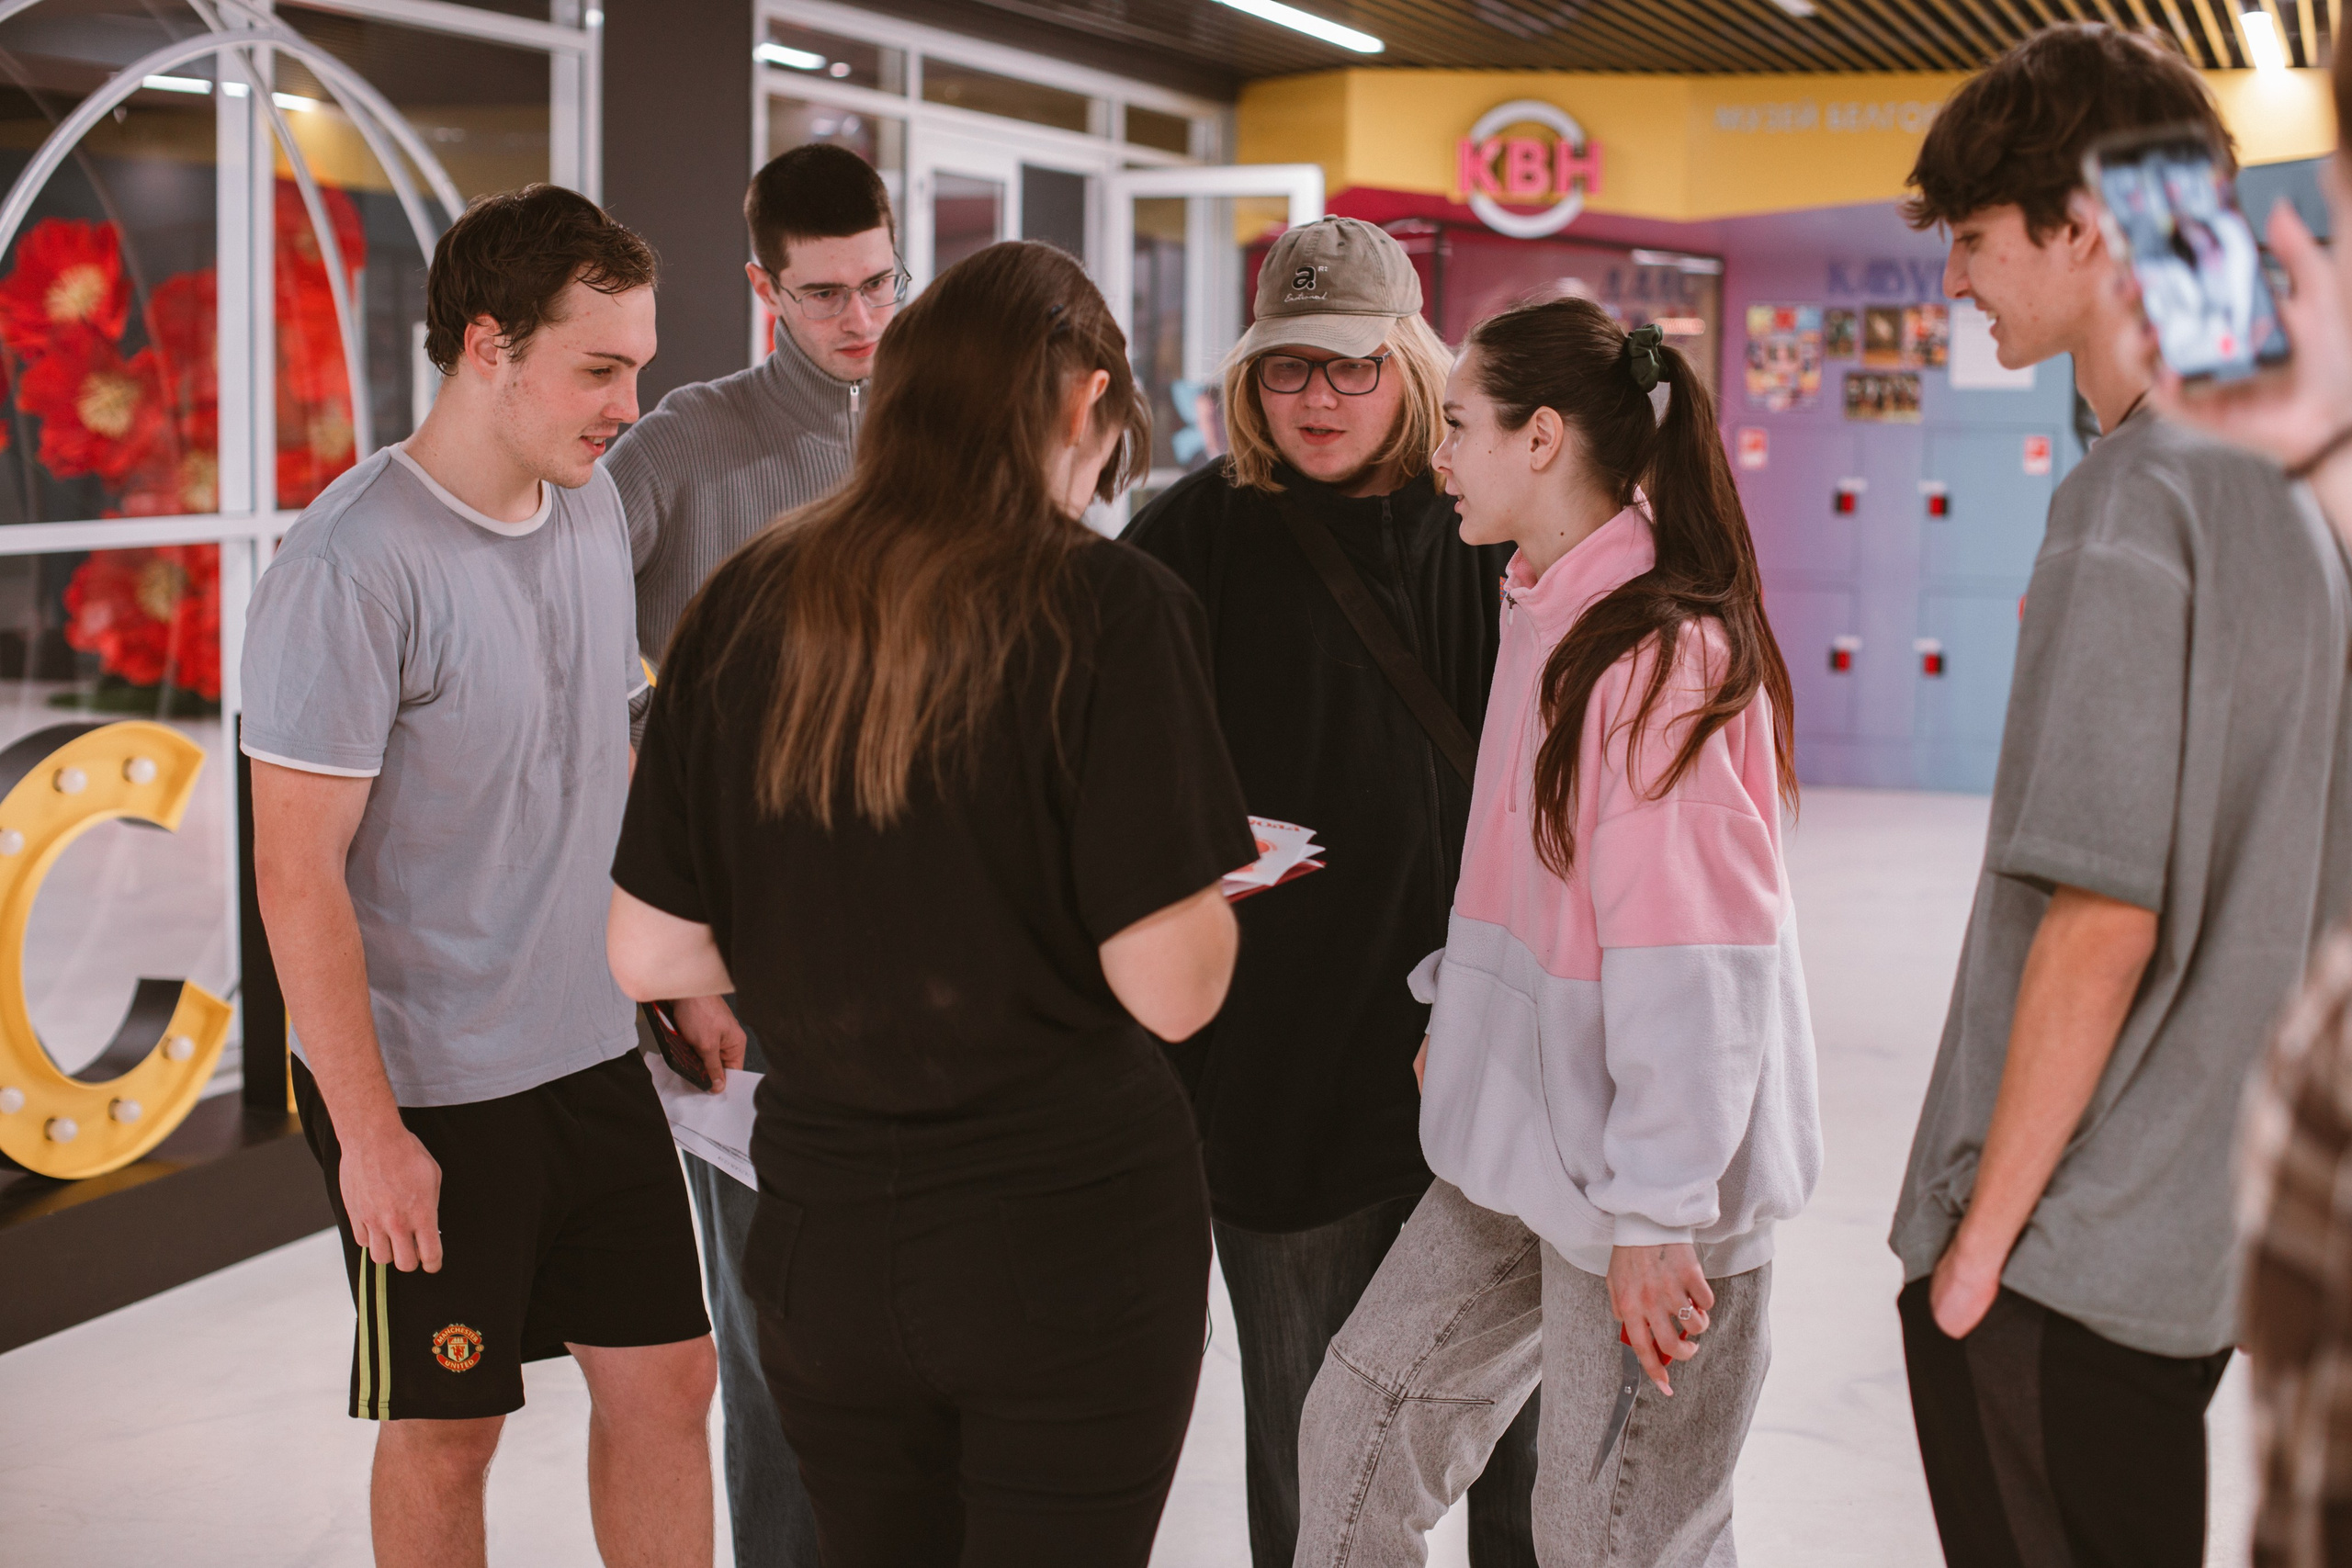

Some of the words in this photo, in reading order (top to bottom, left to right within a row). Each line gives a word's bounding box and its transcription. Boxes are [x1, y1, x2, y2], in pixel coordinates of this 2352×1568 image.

[1458, 137, 1601, 197] КВН
[436, 1326, 479, 1344] MANCHESTER
[445, 1359, 474, 1369] UNITED
